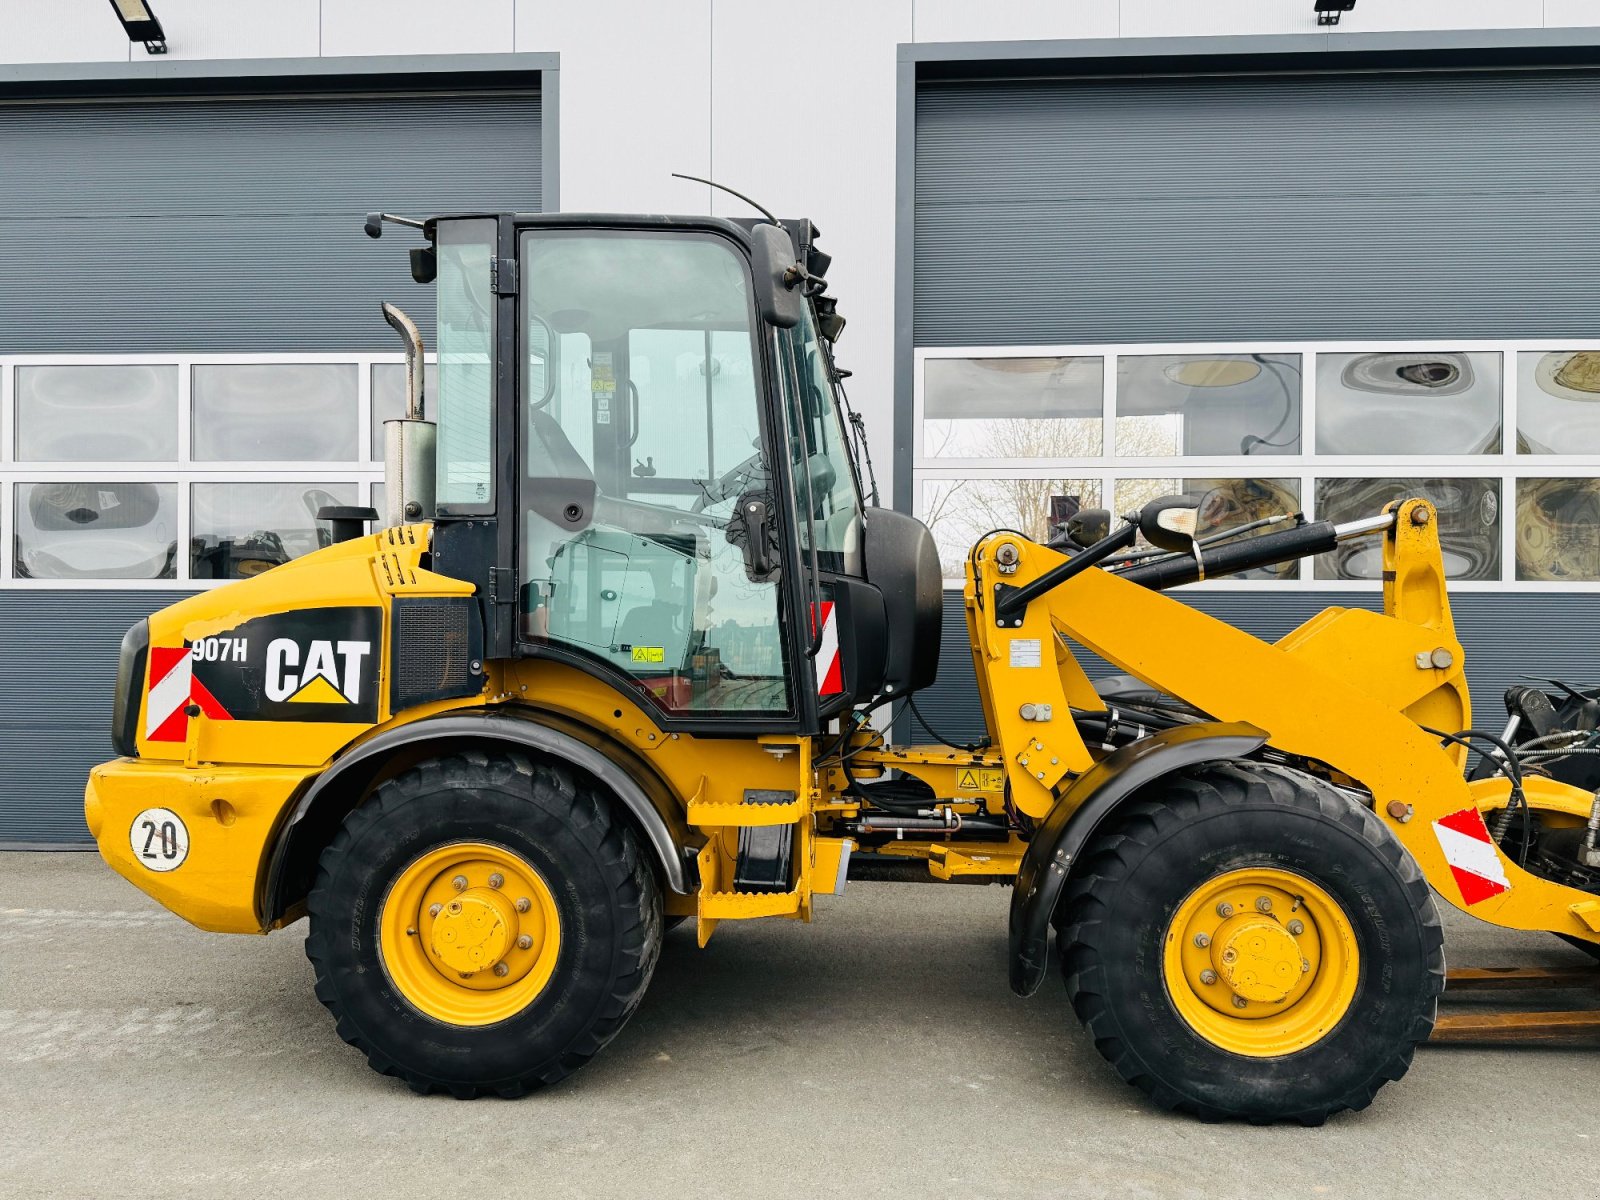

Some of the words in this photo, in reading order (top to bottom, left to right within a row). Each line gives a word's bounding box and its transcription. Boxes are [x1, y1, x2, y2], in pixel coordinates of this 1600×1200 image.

[192, 638, 248, 662] 907H
[265, 638, 371, 704] CAT
[142, 821, 177, 859] 20
